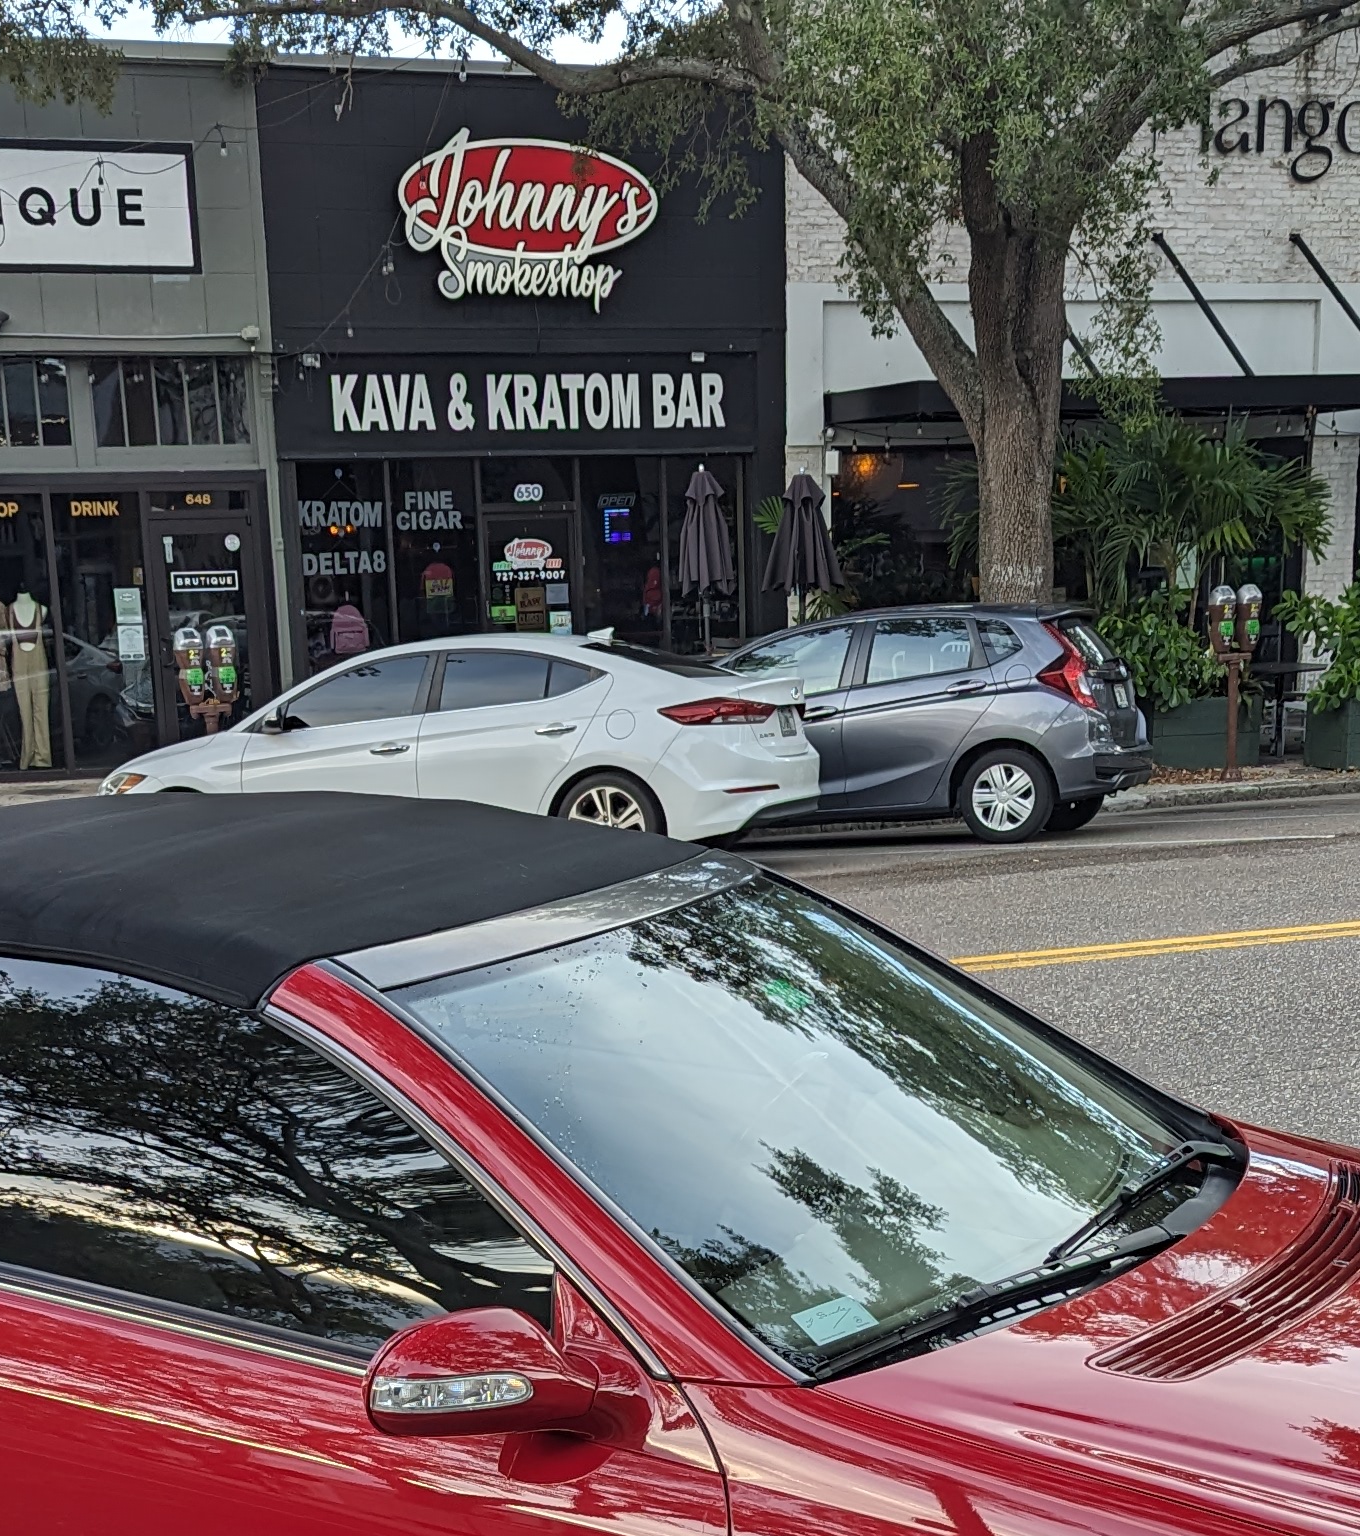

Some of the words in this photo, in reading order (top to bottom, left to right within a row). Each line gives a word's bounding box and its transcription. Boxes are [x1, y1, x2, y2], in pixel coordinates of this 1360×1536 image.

[404, 127, 658, 262] Johnny's
[437, 225, 622, 314] Smokeshop
[331, 373, 435, 431] KAVA
[447, 372, 474, 430] &
[487, 372, 641, 430] KRATOM
[652, 372, 725, 428] BAR
[185, 493, 211, 505] 648
[404, 490, 453, 511] FINE
[515, 485, 542, 500] 650
[601, 496, 633, 506] OPEN
[70, 500, 119, 518] DRINK
[298, 500, 382, 528] KRATOM
[396, 511, 463, 531] CIGAR
[302, 550, 386, 576] DELTA8
[176, 575, 233, 587] BRUTIQUE
[496, 570, 566, 582] 727-327-9007
